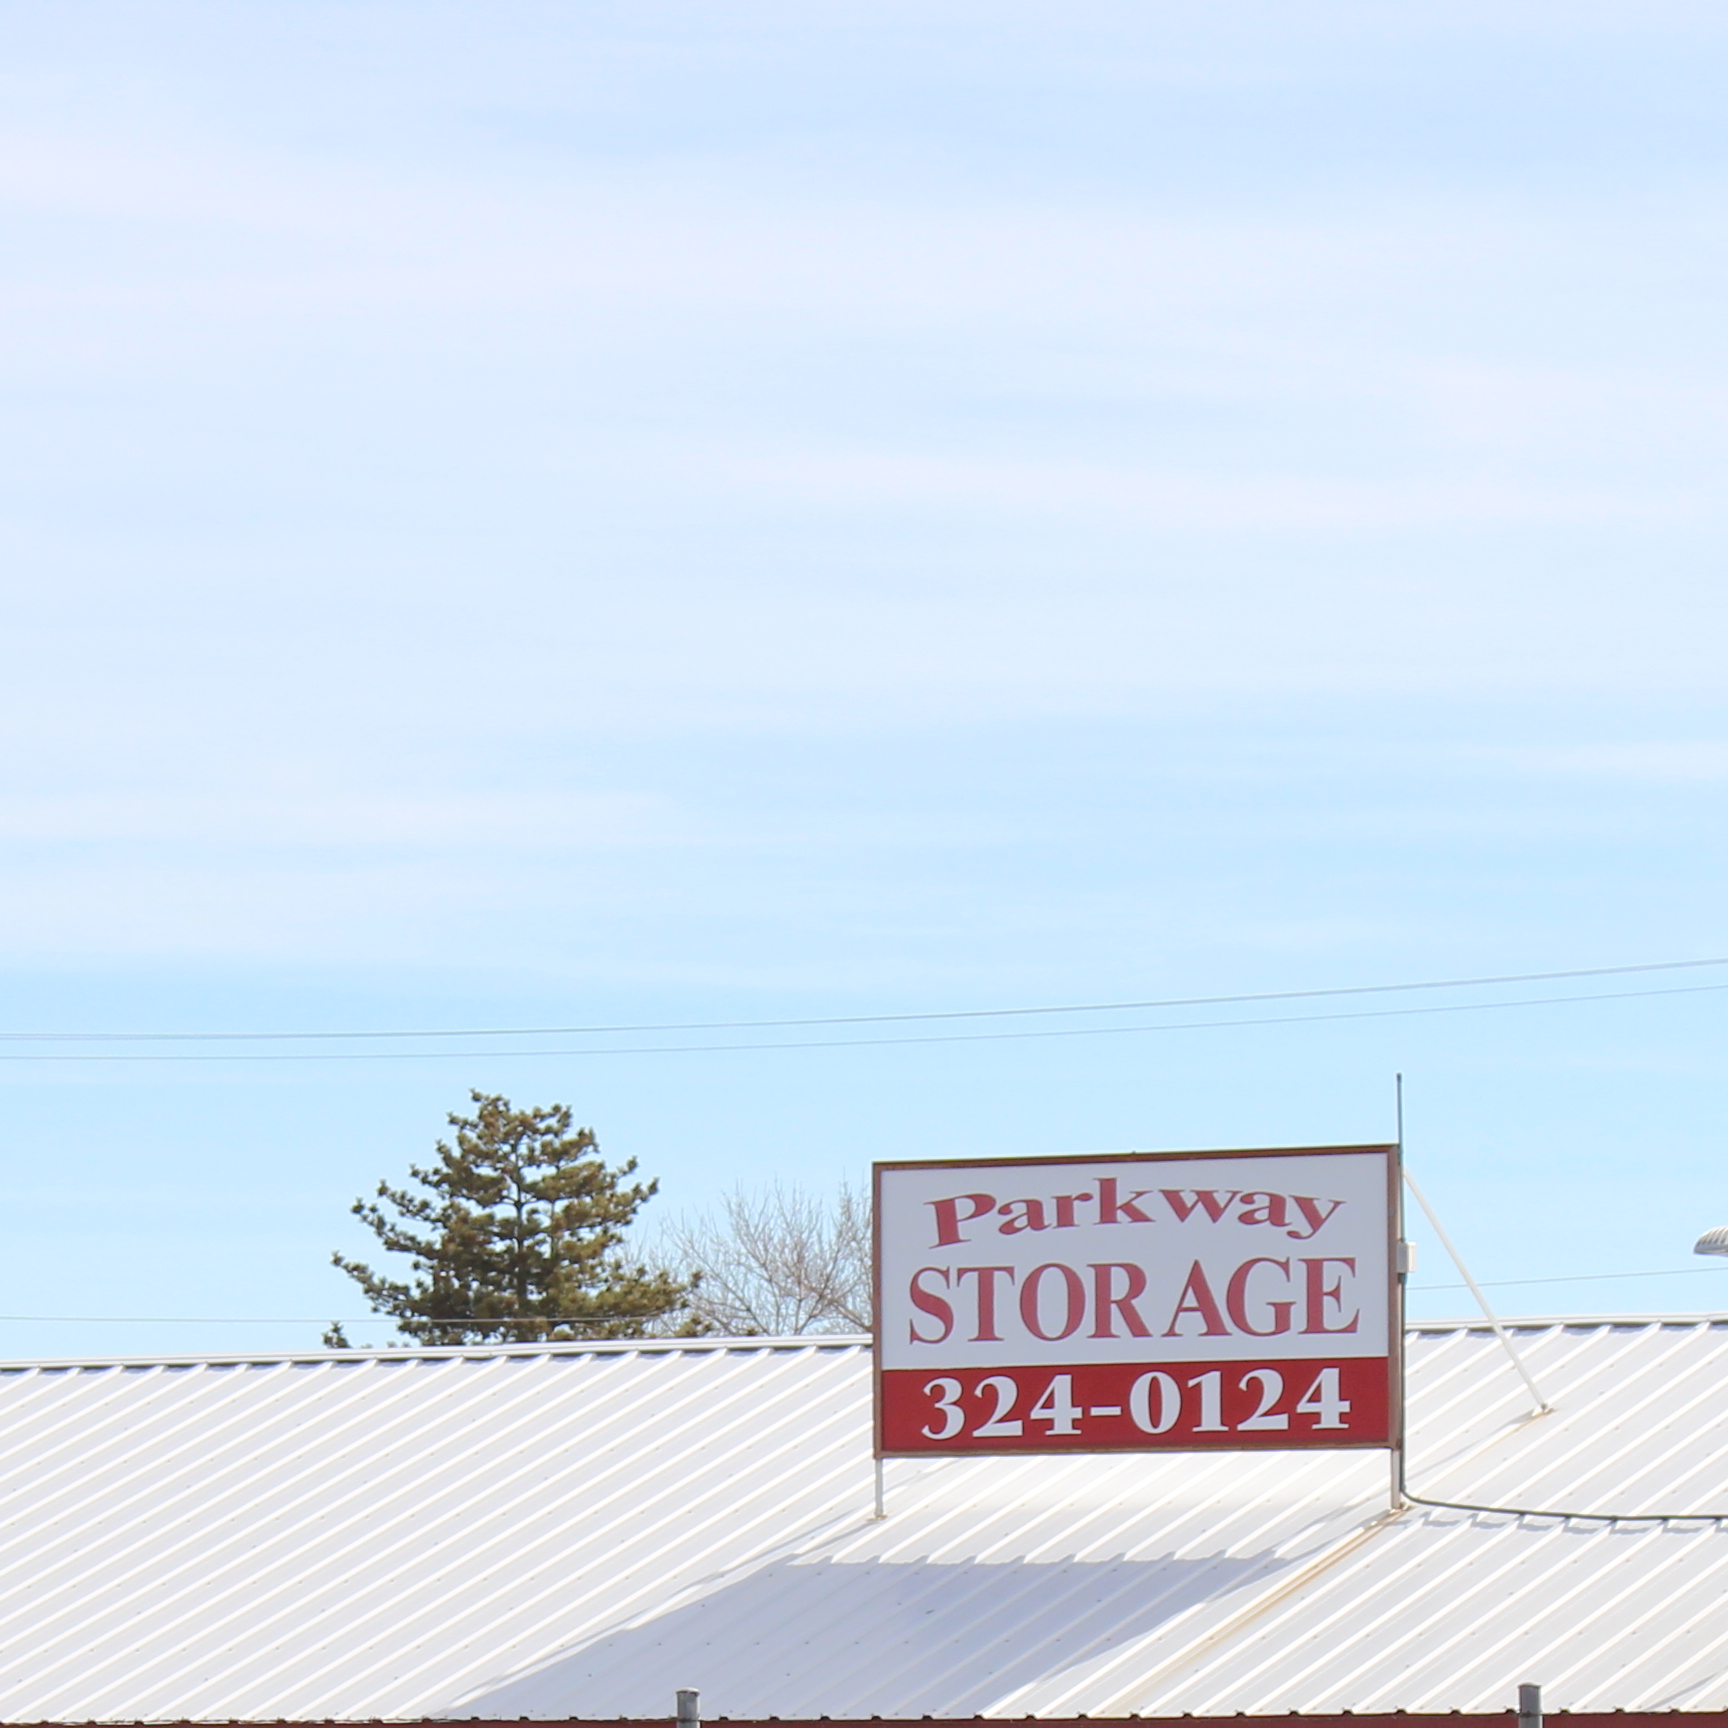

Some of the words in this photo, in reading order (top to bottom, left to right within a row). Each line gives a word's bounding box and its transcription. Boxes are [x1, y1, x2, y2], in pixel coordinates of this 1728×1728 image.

[924, 1177, 1346, 1248] Parkway
[909, 1257, 1360, 1344] STORAGE
[921, 1367, 1351, 1440] 324-0124
